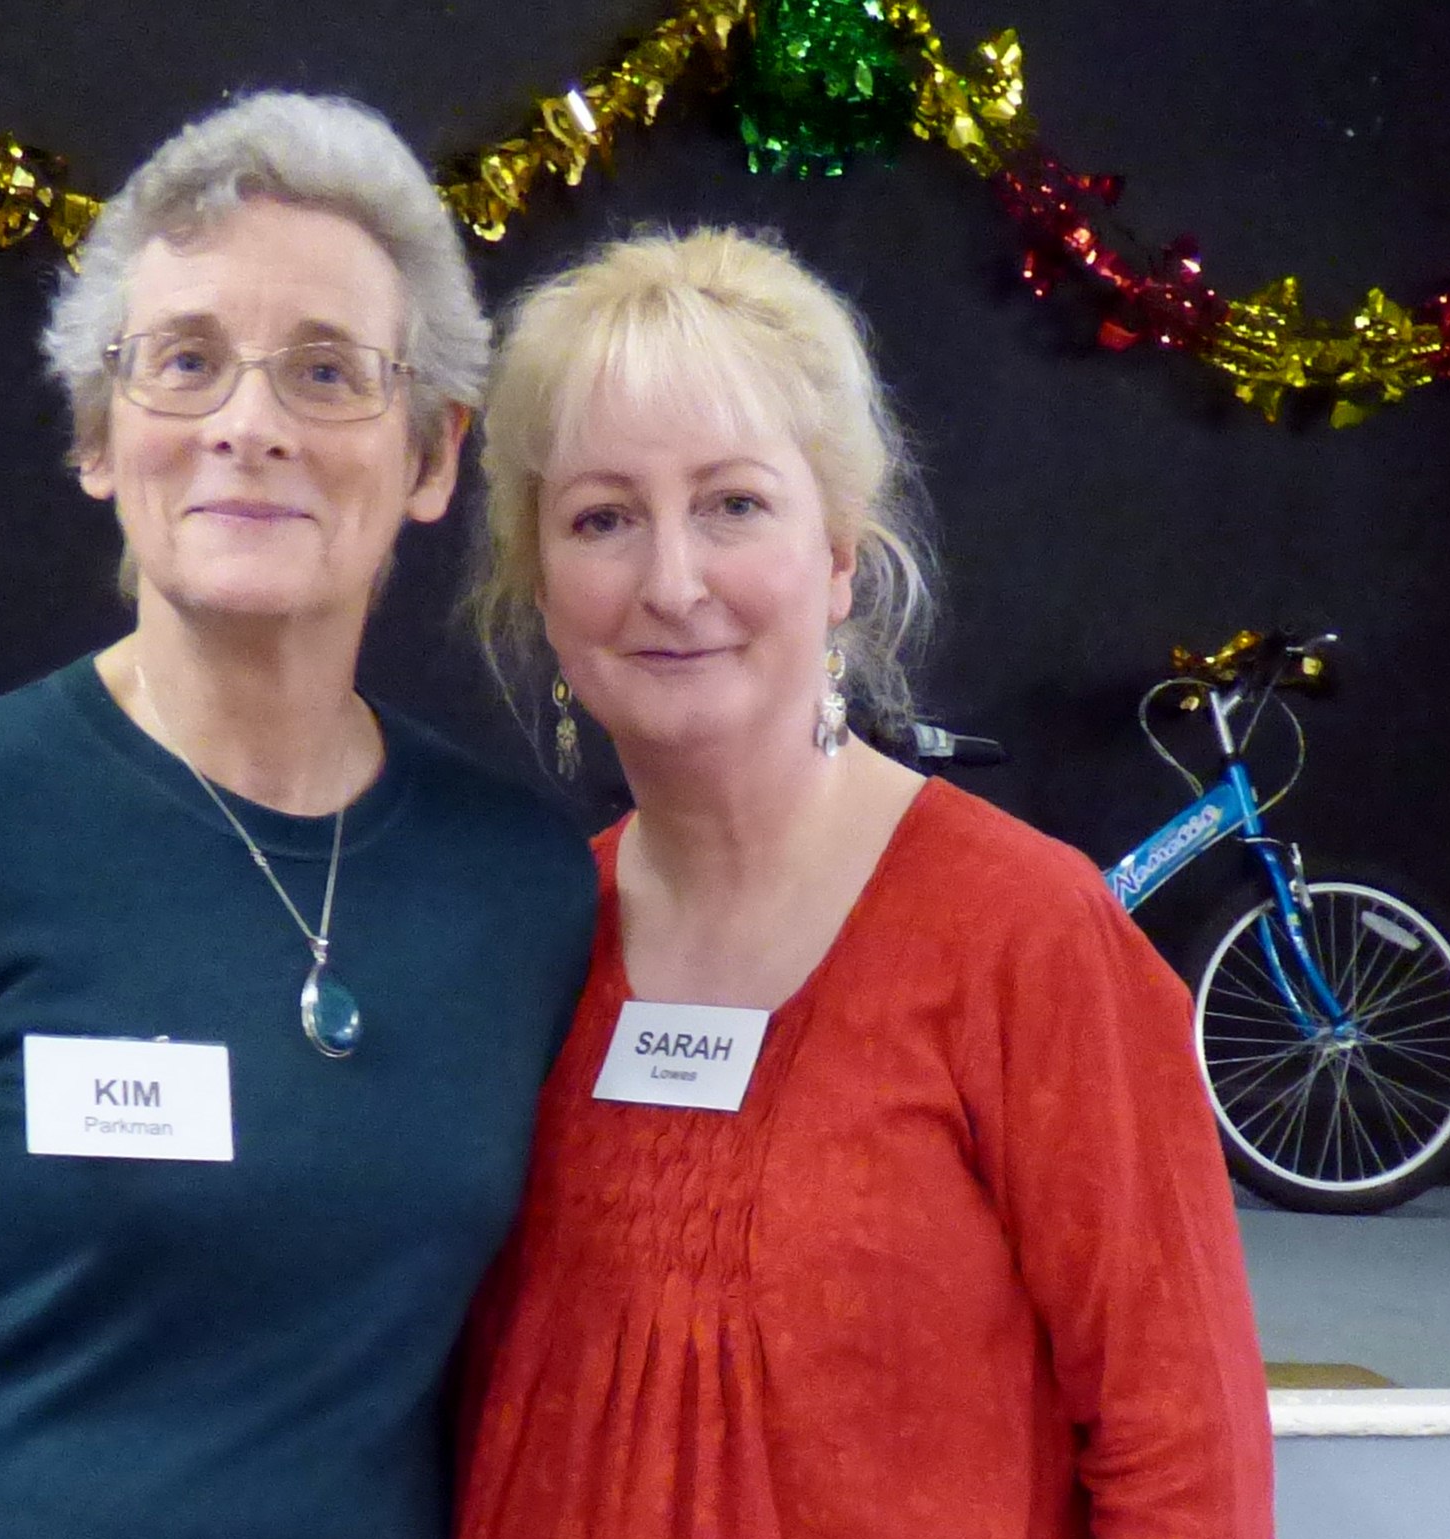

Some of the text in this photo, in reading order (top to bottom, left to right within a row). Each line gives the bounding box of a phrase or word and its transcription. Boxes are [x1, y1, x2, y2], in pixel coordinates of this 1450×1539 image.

[635, 1031, 734, 1061] SARAH
[95, 1079, 160, 1107] KIM
[84, 1116, 173, 1136] Parkman
